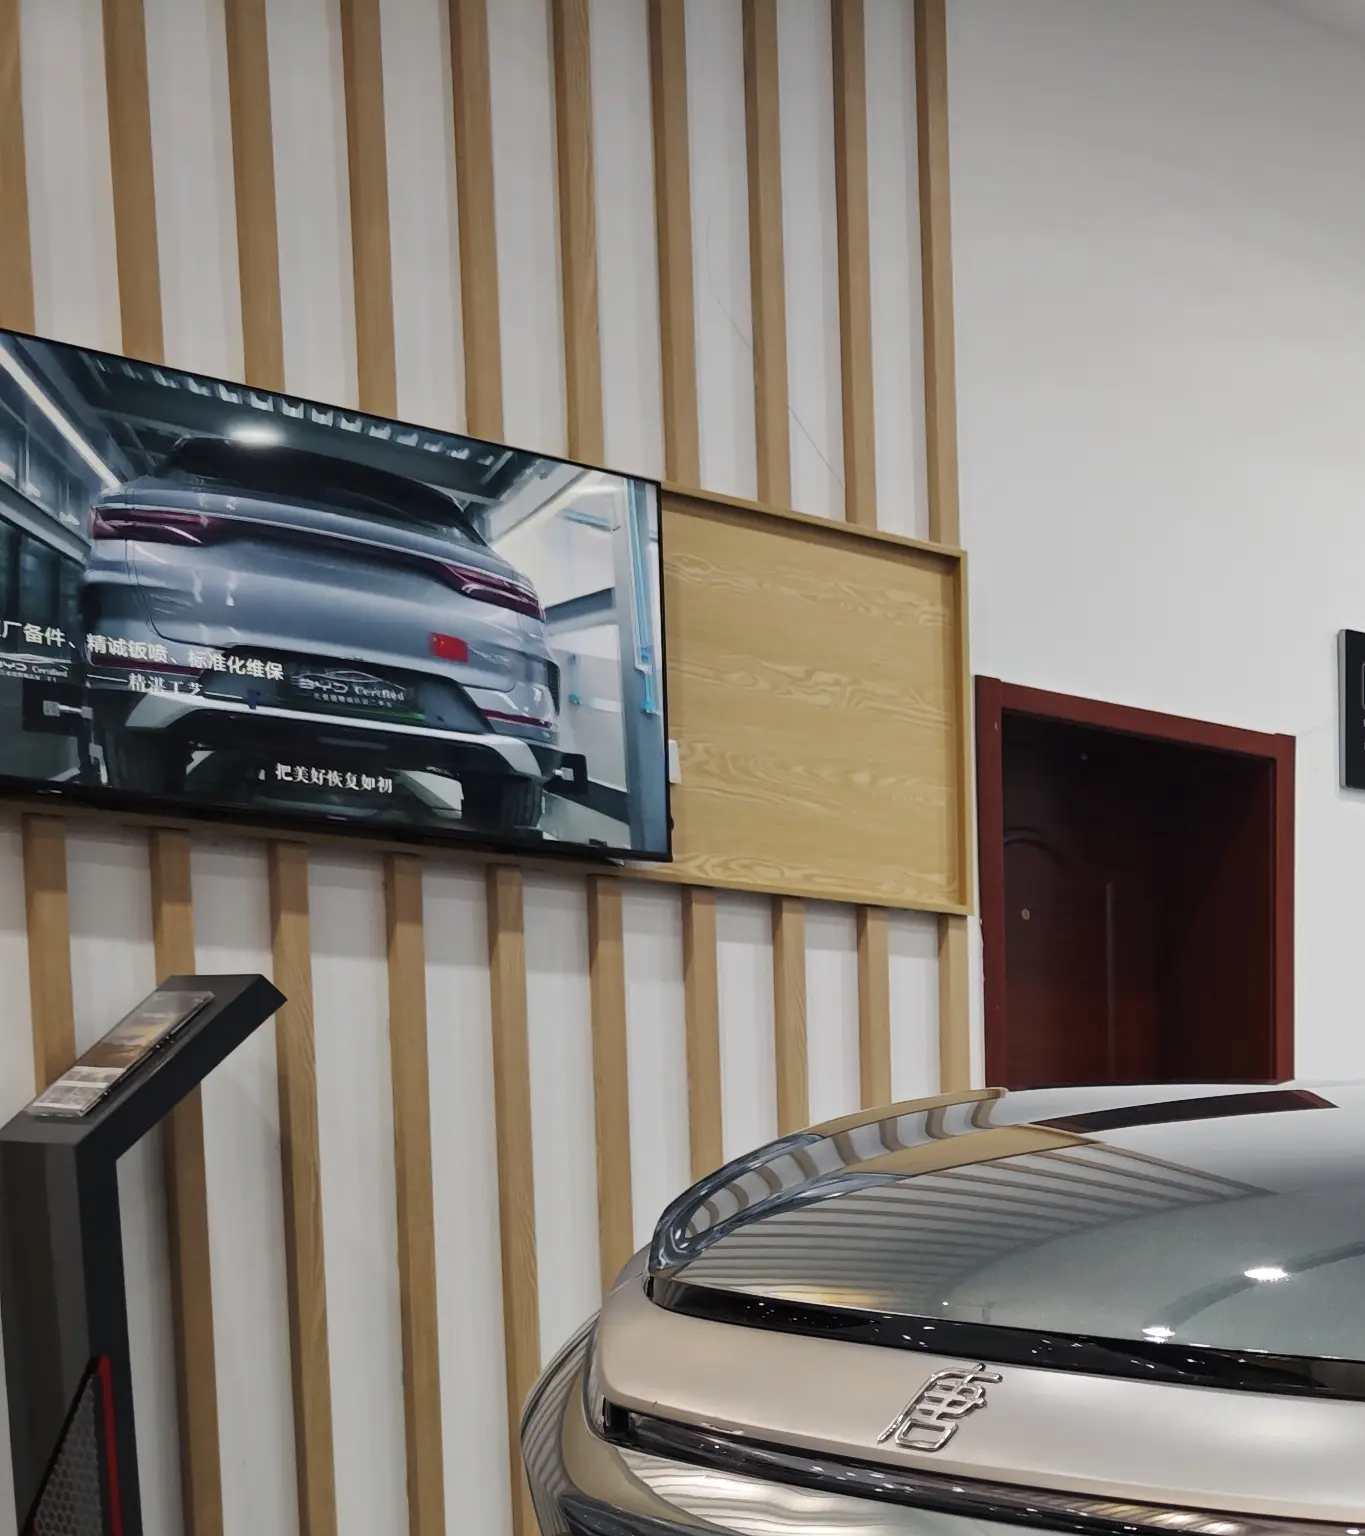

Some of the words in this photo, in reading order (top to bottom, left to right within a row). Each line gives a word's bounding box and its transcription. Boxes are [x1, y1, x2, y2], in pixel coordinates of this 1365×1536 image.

[0, 619, 285, 681] 厂备件、精诚钣喷、标准化维保
[299, 678, 349, 694] BYD
[275, 762, 393, 794] 把美好恢复如初
